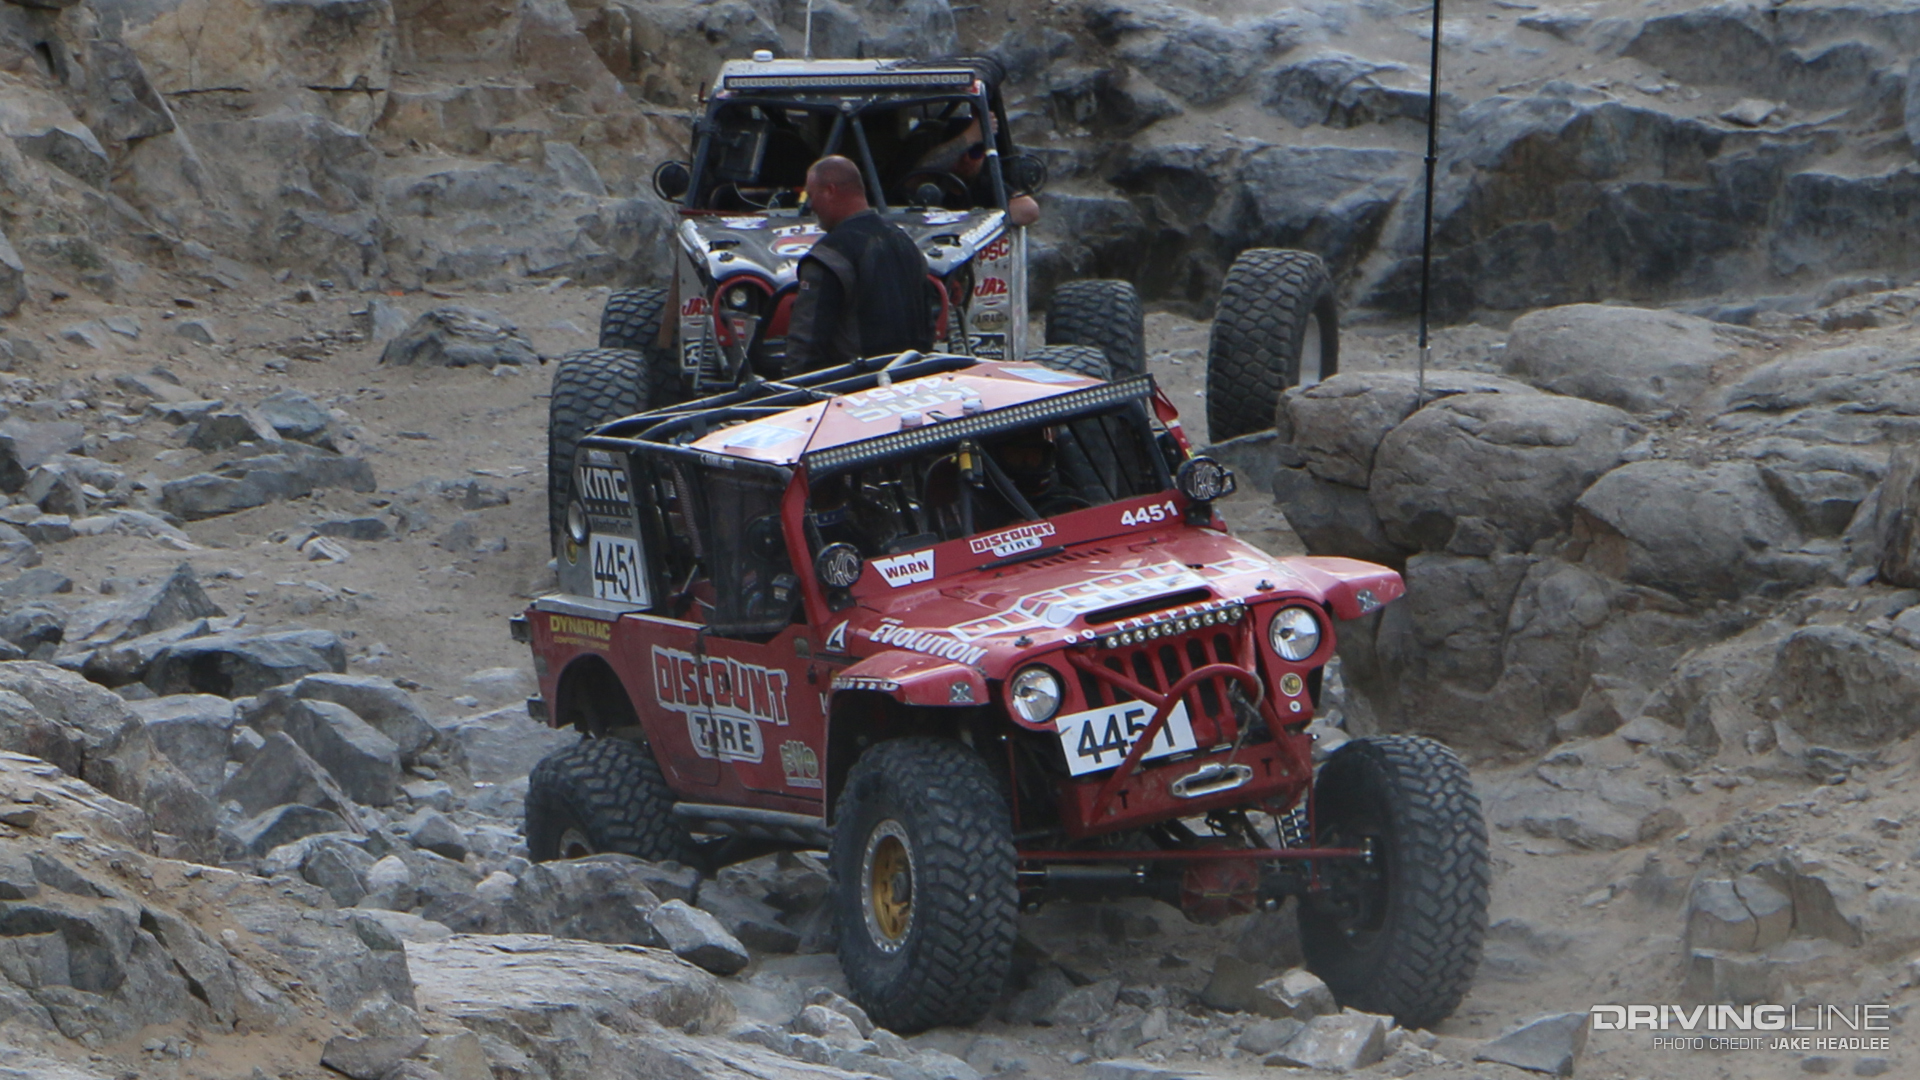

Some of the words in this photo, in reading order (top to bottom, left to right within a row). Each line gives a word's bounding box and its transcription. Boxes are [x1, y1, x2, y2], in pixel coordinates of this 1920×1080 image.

[682, 298, 709, 316] JA
[580, 467, 629, 502] KMC
[1193, 464, 1221, 500] KC
[1121, 500, 1178, 526] 4451
[970, 522, 1056, 553] DISCOUNT
[1000, 538, 1036, 553] TIRE
[594, 541, 640, 602] 4451
[828, 553, 859, 586] KC
[884, 560, 930, 578] WARN
[950, 557, 1264, 642] DISCOU
[550, 615, 611, 641] DYNATRAC
[869, 623, 989, 665] EVOLUTION
[652, 644, 789, 726] DISCOUNT
[694, 716, 755, 754] TIRE
[1077, 709, 1176, 765] 4451
